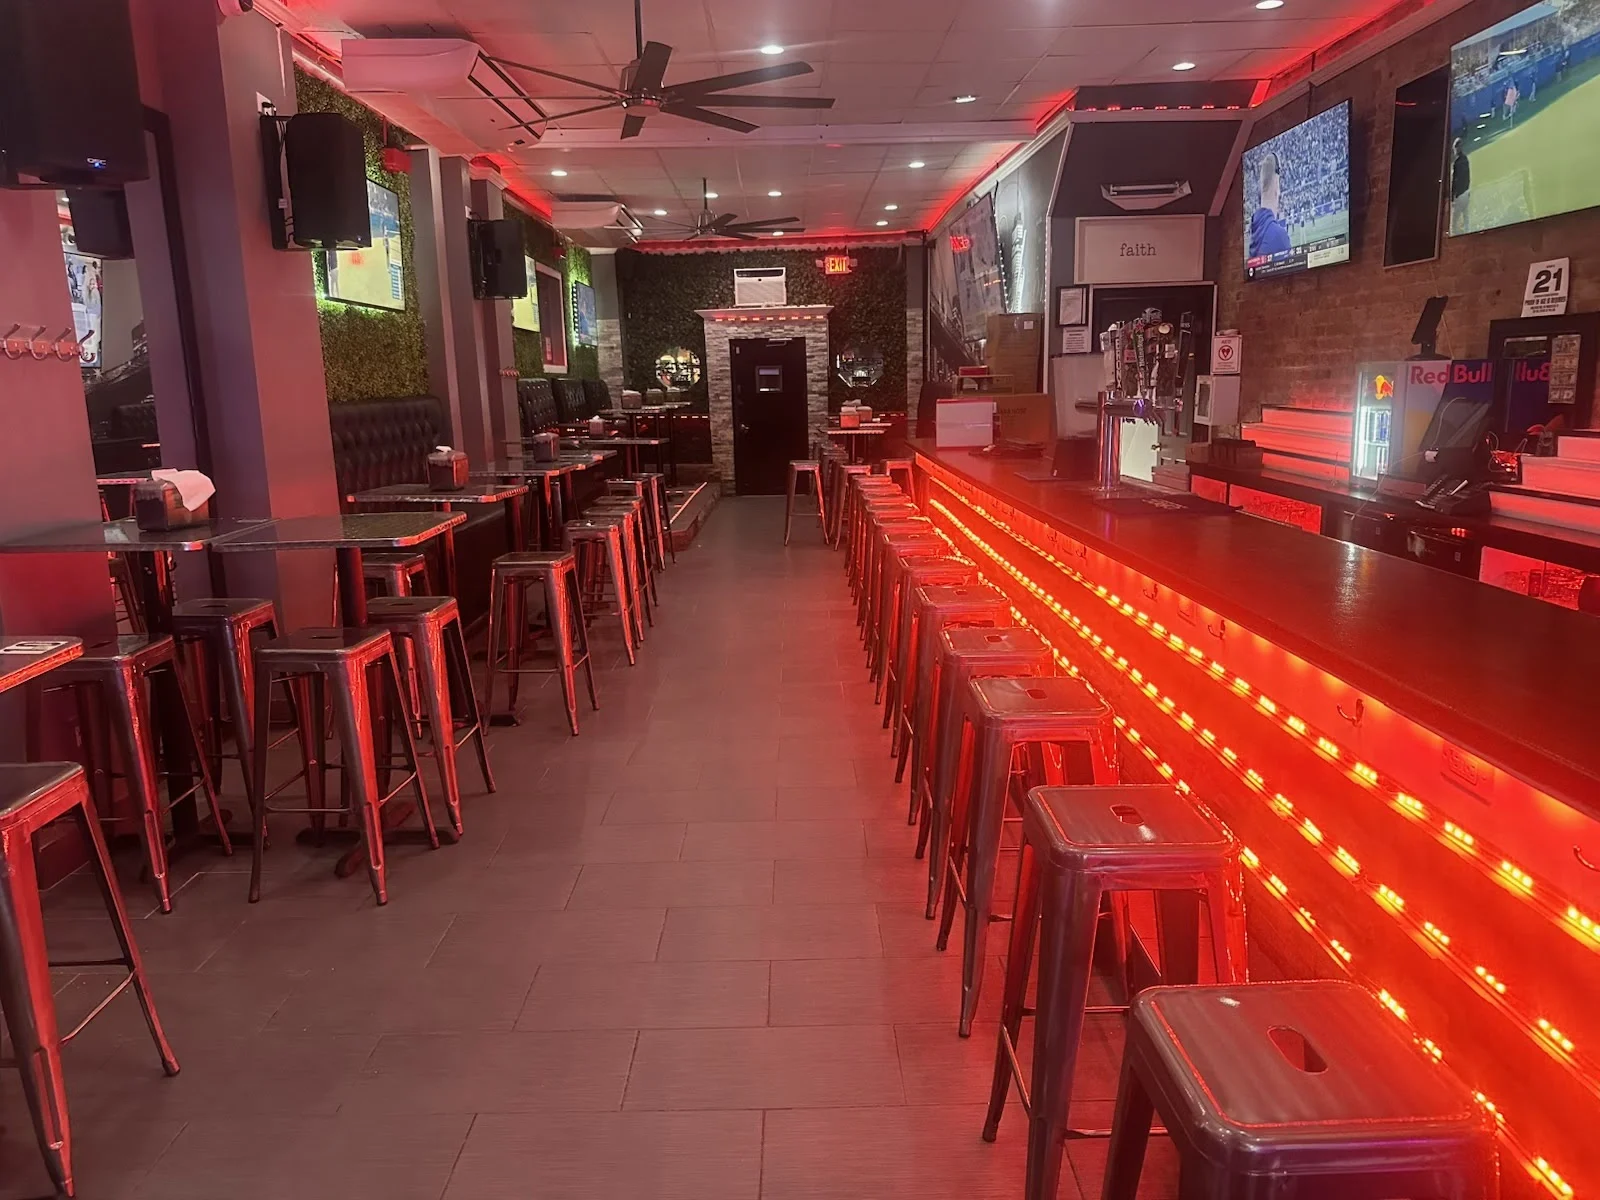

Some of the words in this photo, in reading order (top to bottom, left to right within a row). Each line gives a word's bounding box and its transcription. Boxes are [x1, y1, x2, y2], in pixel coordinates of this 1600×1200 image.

[1120, 243, 1157, 257] faith
[829, 257, 847, 272] EXIT
[1532, 268, 1563, 293] 21
[1411, 365, 1450, 385] Red
[1454, 362, 1492, 384] Bull
